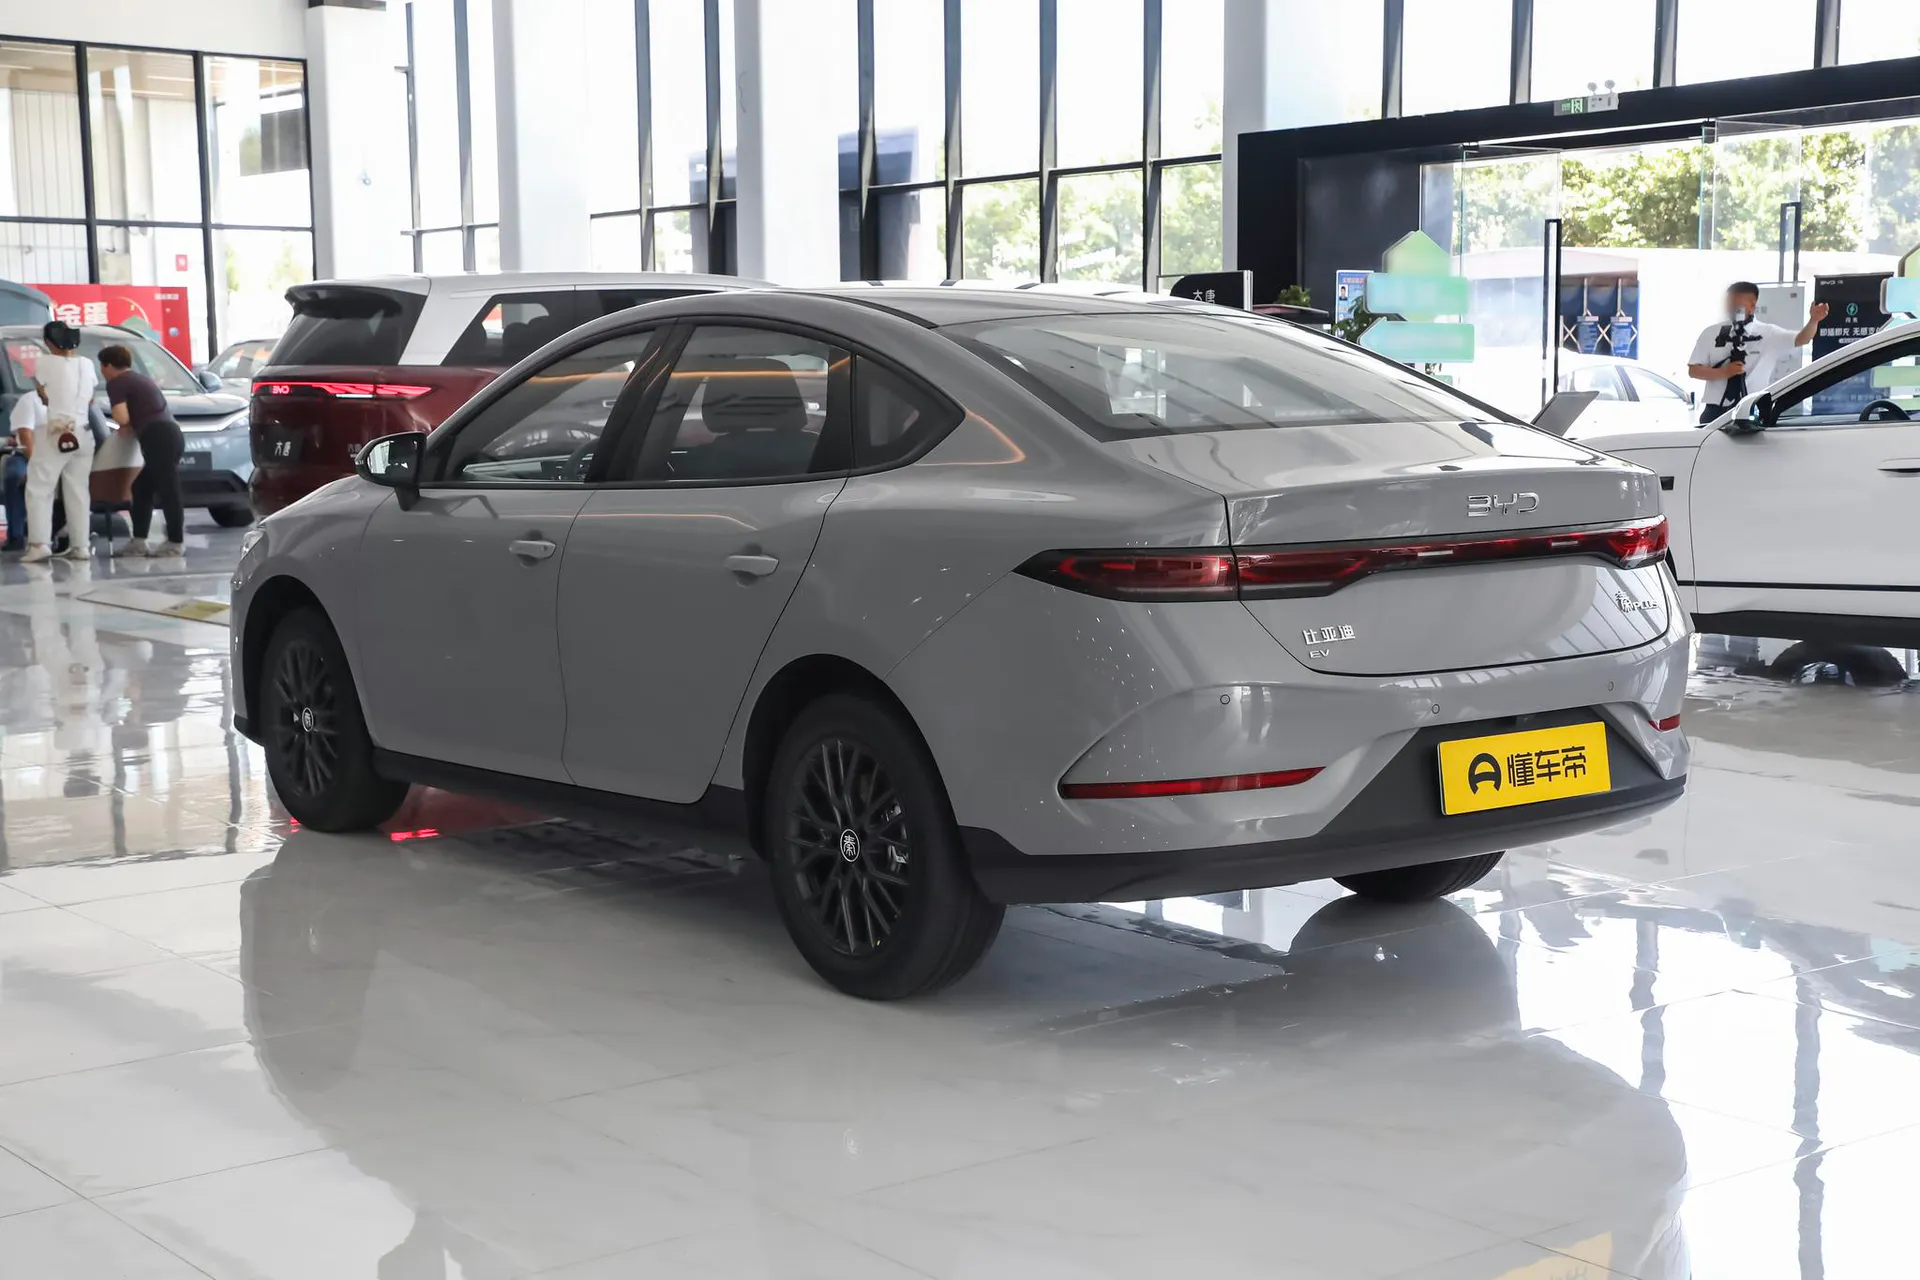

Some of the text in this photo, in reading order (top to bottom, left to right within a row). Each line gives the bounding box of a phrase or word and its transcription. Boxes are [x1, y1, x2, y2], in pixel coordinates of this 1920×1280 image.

[1192, 289, 1216, 304] 大唐
[1468, 492, 1540, 517] BYD
[1302, 624, 1356, 645] 比亚迪
[1309, 648, 1330, 659] EV
[1506, 745, 1588, 788] 懂车帝
